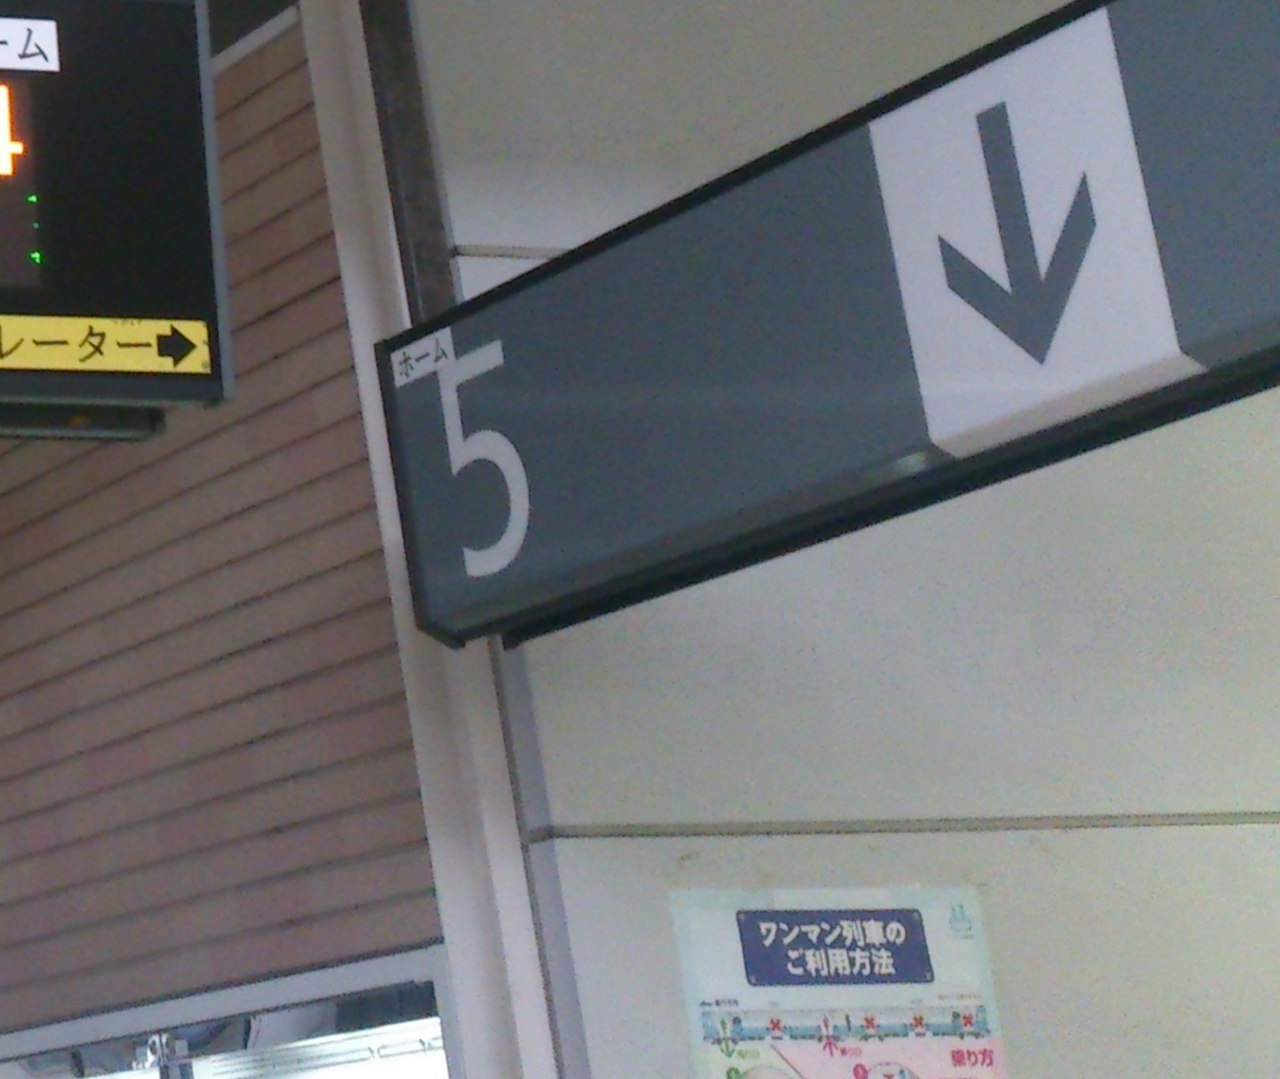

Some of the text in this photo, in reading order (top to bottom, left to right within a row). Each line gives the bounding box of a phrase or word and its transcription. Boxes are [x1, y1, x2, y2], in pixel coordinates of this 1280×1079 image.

[398, 338, 448, 379] ホーム
[437, 339, 530, 578] 5
[758, 919, 907, 948] ワンマン列車の
[787, 948, 897, 977] ご利用方法
